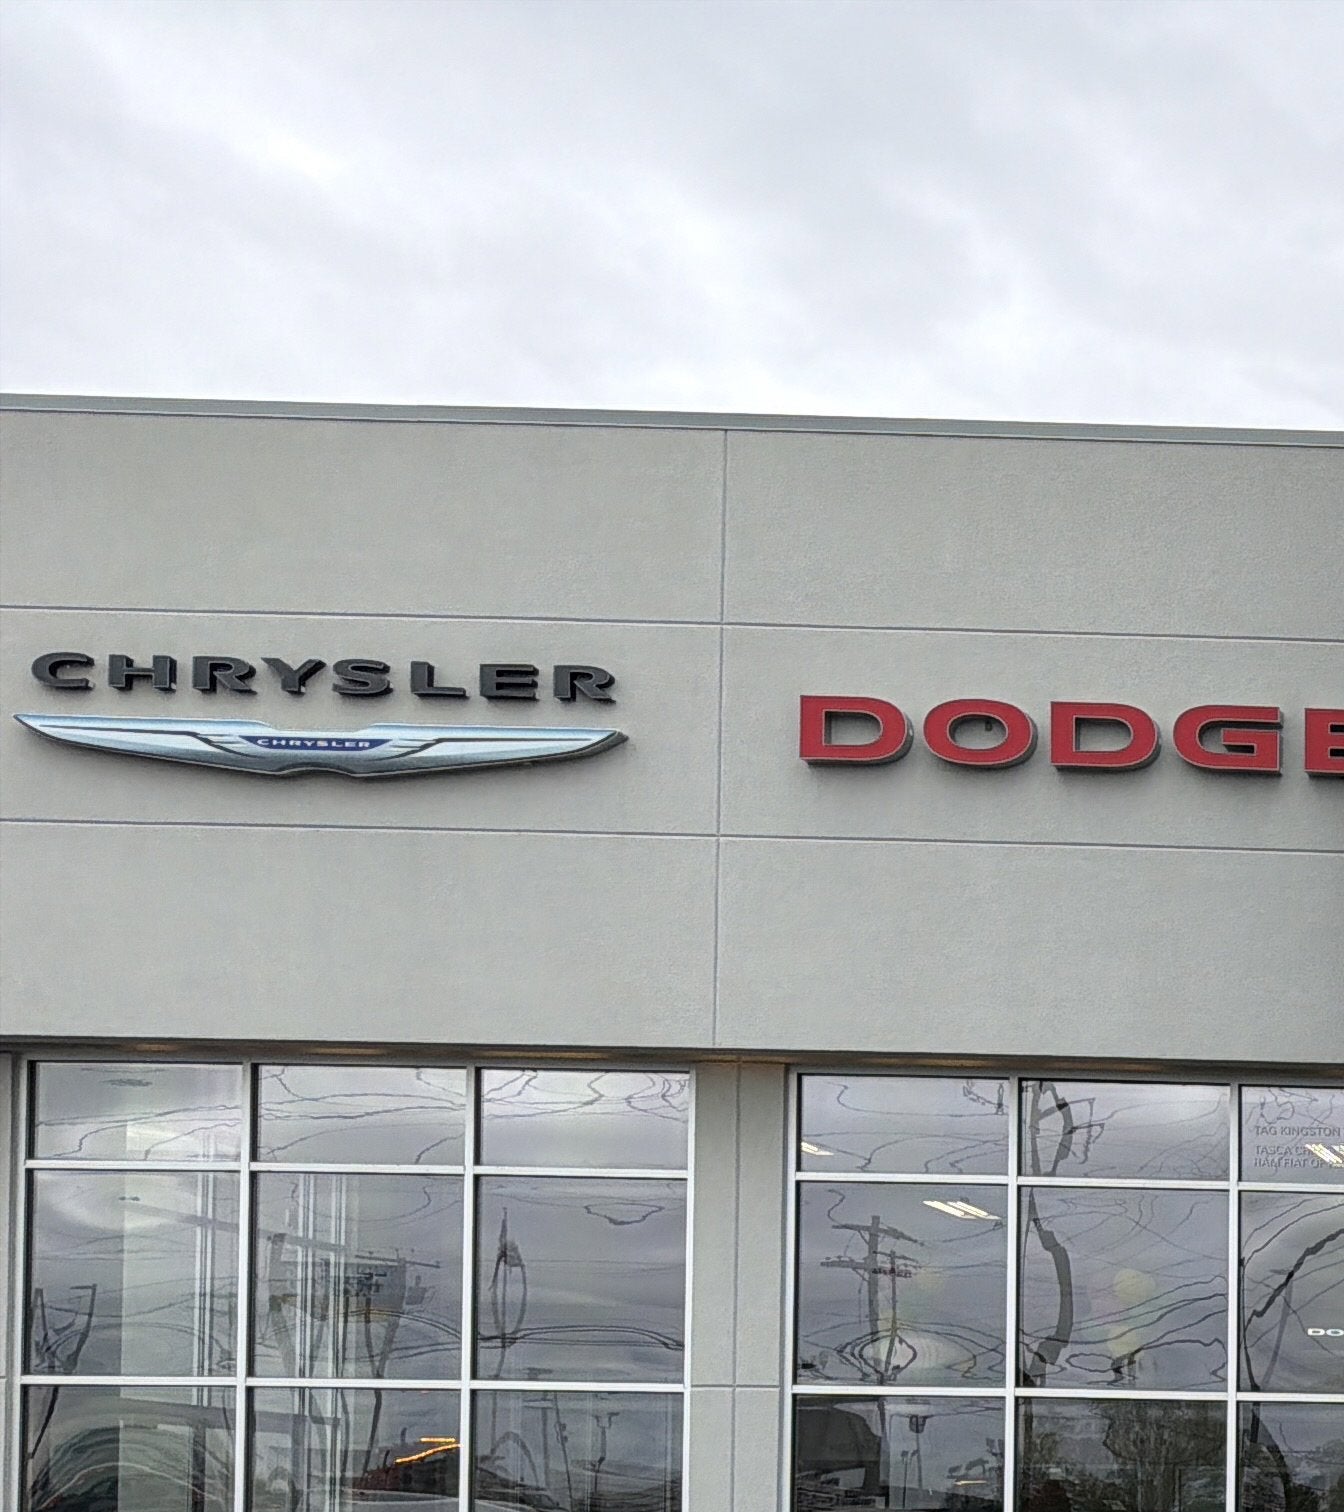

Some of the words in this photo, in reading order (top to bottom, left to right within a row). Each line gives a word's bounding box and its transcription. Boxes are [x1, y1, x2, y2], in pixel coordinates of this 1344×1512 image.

[31, 651, 617, 703] CHRYSLER
[257, 738, 370, 748] CHRYSLER
[1281, 1126, 1341, 1137] KINGSTON
